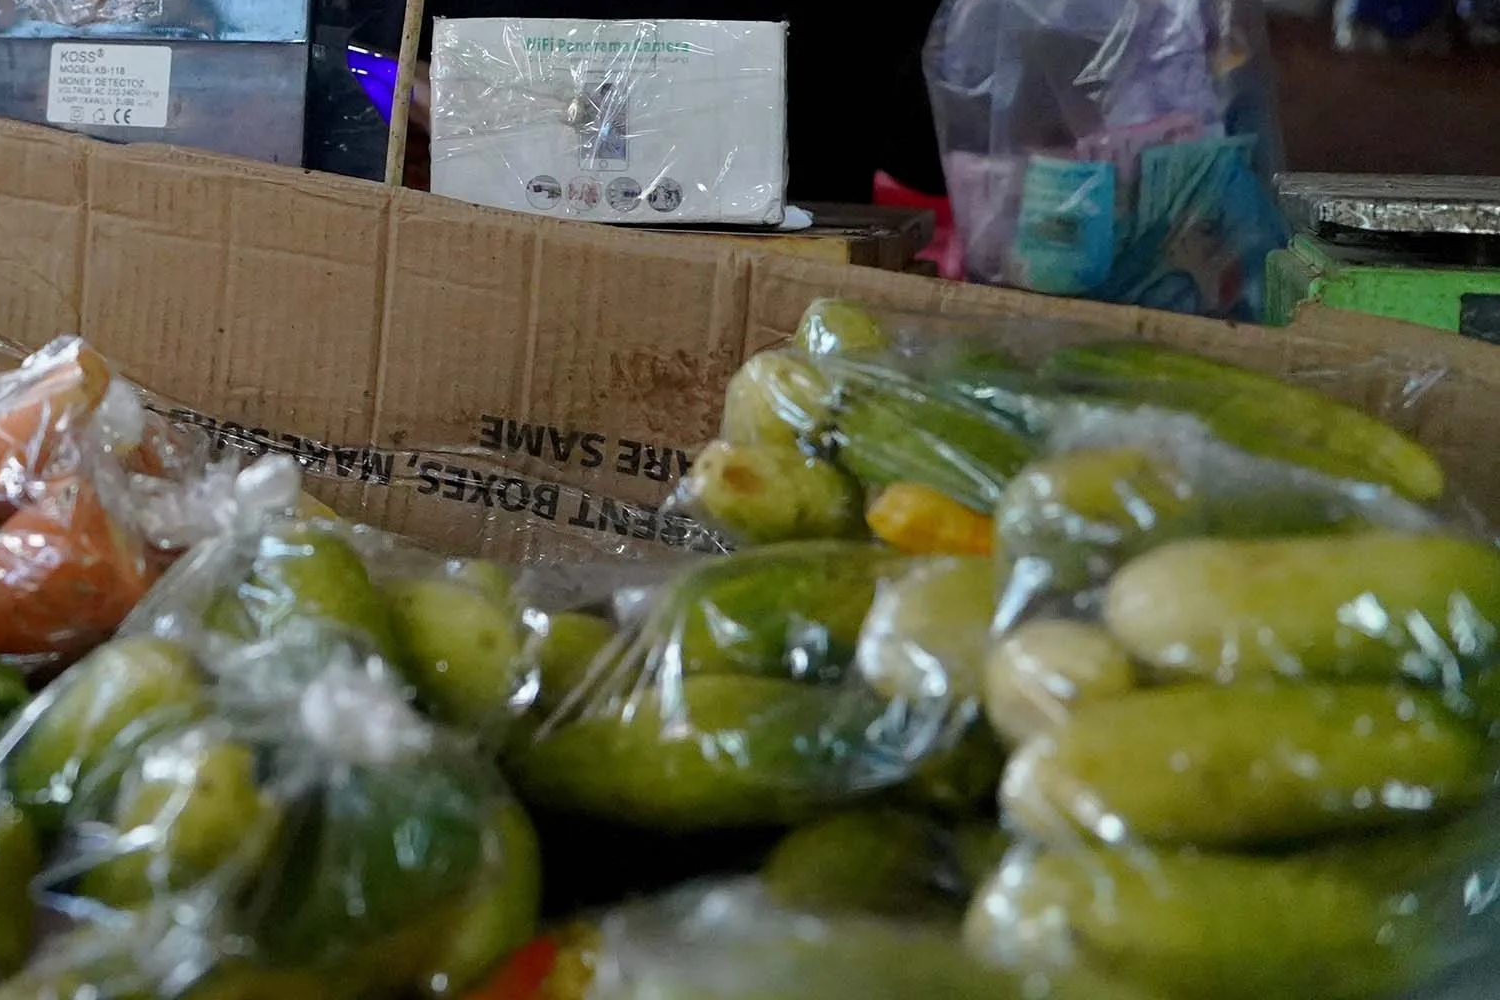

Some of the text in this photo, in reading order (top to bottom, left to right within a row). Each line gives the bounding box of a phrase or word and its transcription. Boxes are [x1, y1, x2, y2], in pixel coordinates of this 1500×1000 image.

[524, 37, 691, 54] WiFi Panorama Camera
[59, 77, 91, 86] MONEY
[480, 414, 606, 469] SAME
[406, 452, 560, 522] BOXES,
